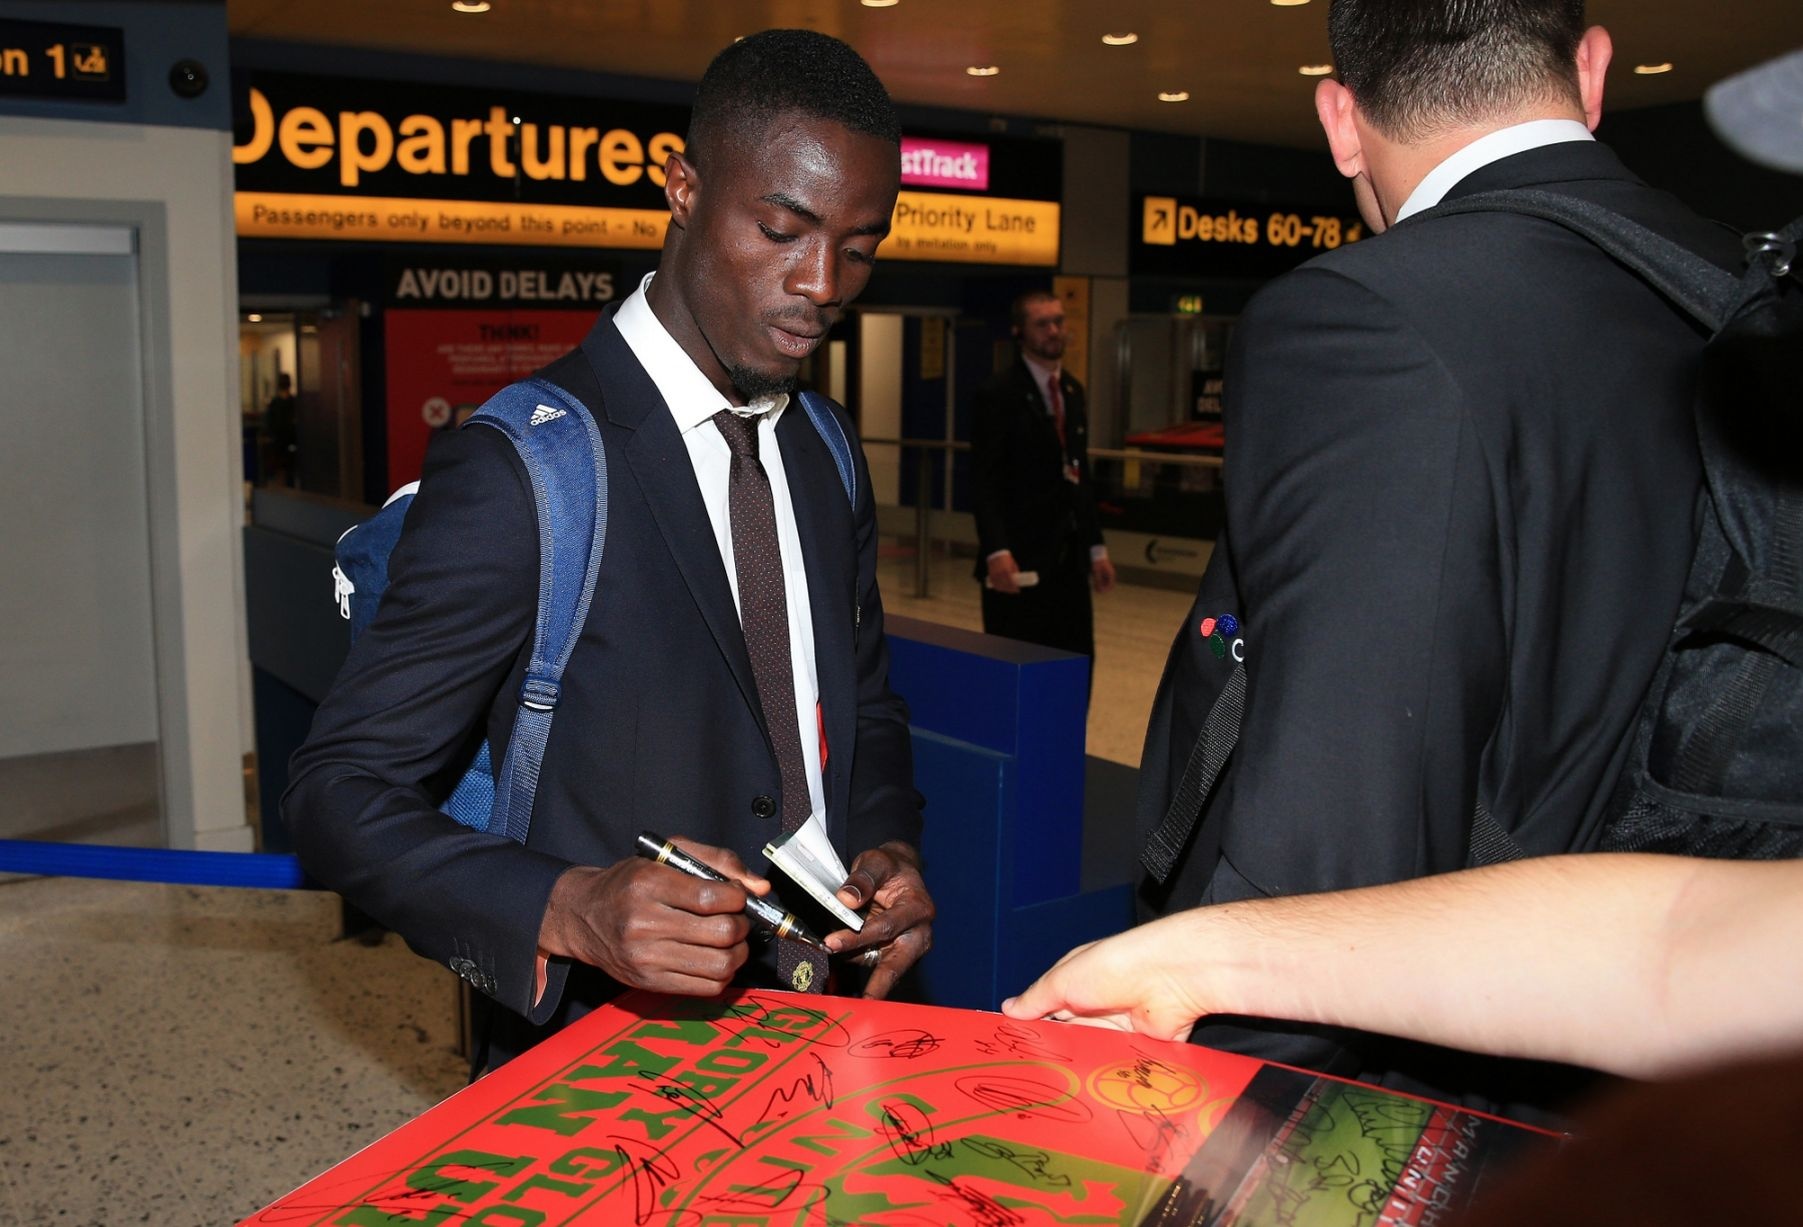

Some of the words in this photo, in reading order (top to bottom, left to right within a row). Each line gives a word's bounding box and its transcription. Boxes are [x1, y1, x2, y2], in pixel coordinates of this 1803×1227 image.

[0, 48, 29, 76] n
[45, 43, 65, 79] 1
[253, 204, 378, 230] Passengers
[387, 211, 429, 232] only
[438, 210, 511, 236] beyond
[520, 214, 555, 234] this
[562, 216, 608, 236] point
[632, 220, 657, 238] No
[896, 202, 976, 233] Priority
[986, 209, 1037, 233] Lane
[1177, 204, 1259, 244] Desks
[1267, 212, 1342, 249] 60-78
[396, 268, 493, 299] AVOID
[500, 270, 615, 300] DELAYS
[479, 323, 540, 341] THINK!
[530, 408, 567, 426] adidas
[616, 1006, 829, 1141] GLORY
